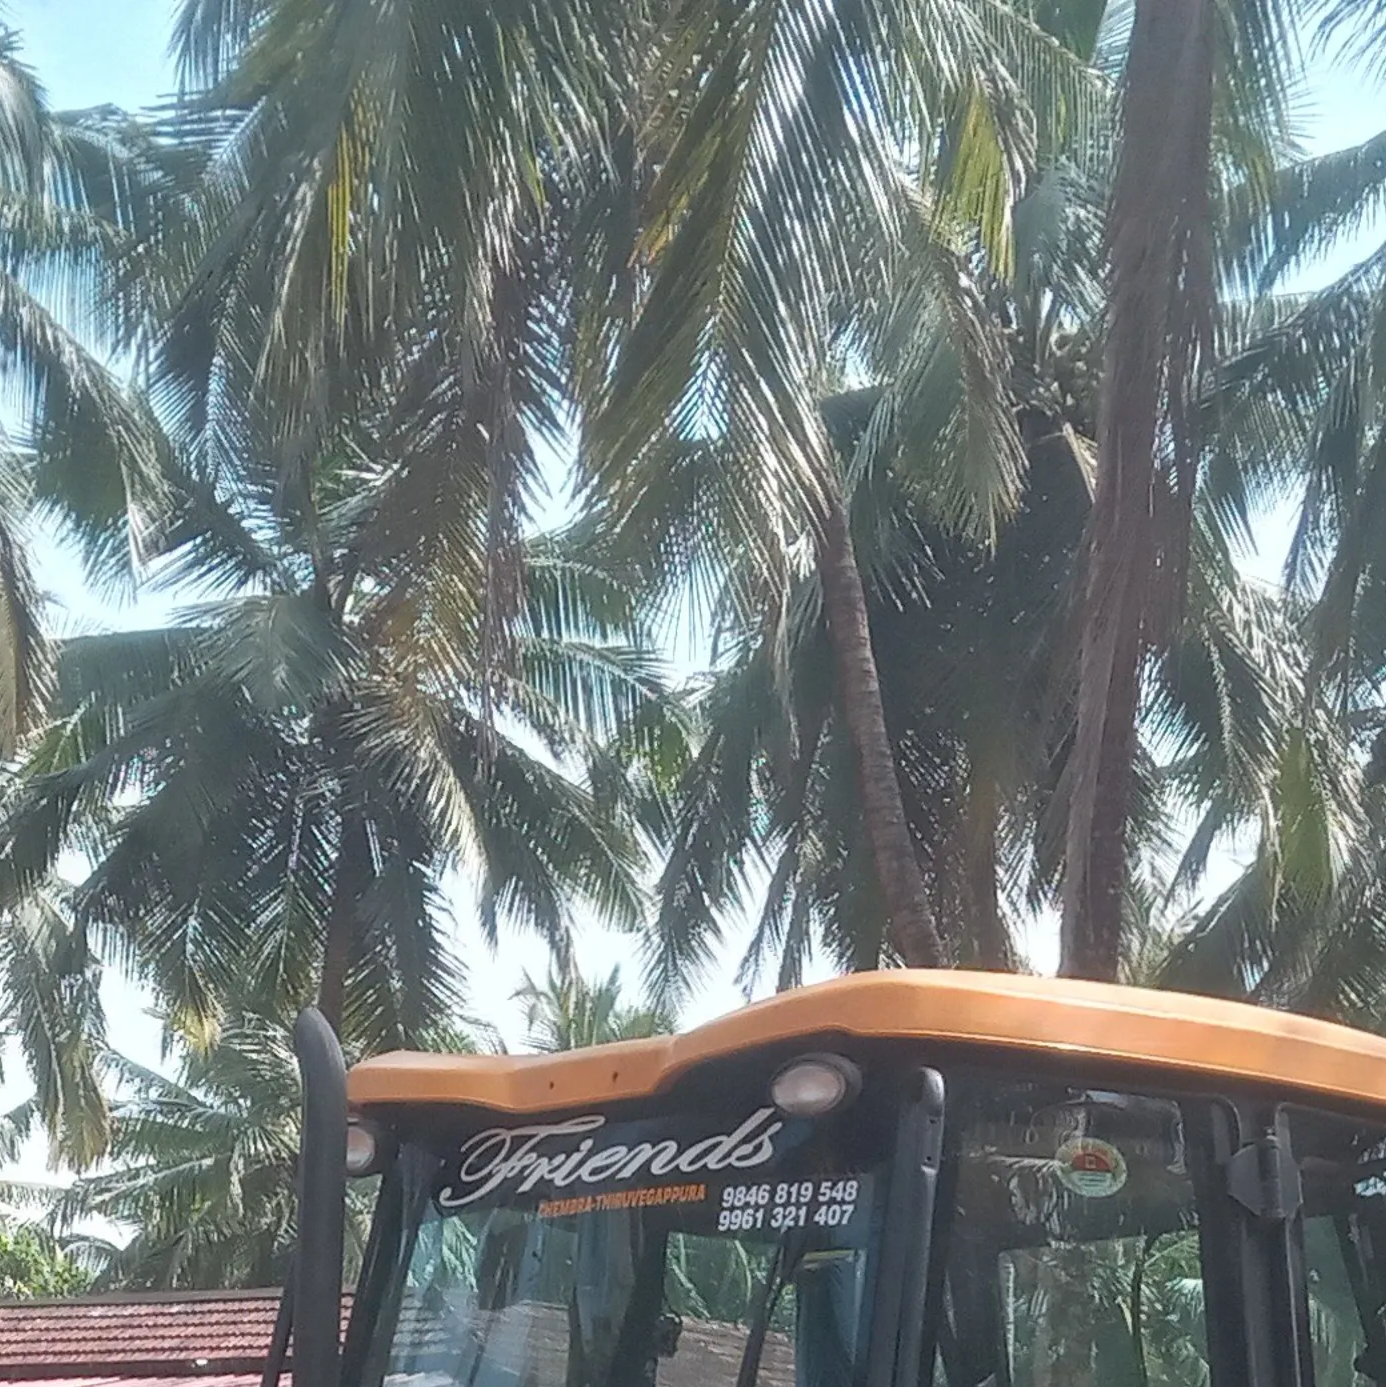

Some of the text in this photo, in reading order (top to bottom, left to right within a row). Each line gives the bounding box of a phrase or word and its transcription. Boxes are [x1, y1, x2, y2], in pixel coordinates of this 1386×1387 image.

[439, 1107, 782, 1206] Friends
[721, 1180, 859, 1208] 9846 819 548
[717, 1204, 855, 1231] 9961 321 407
